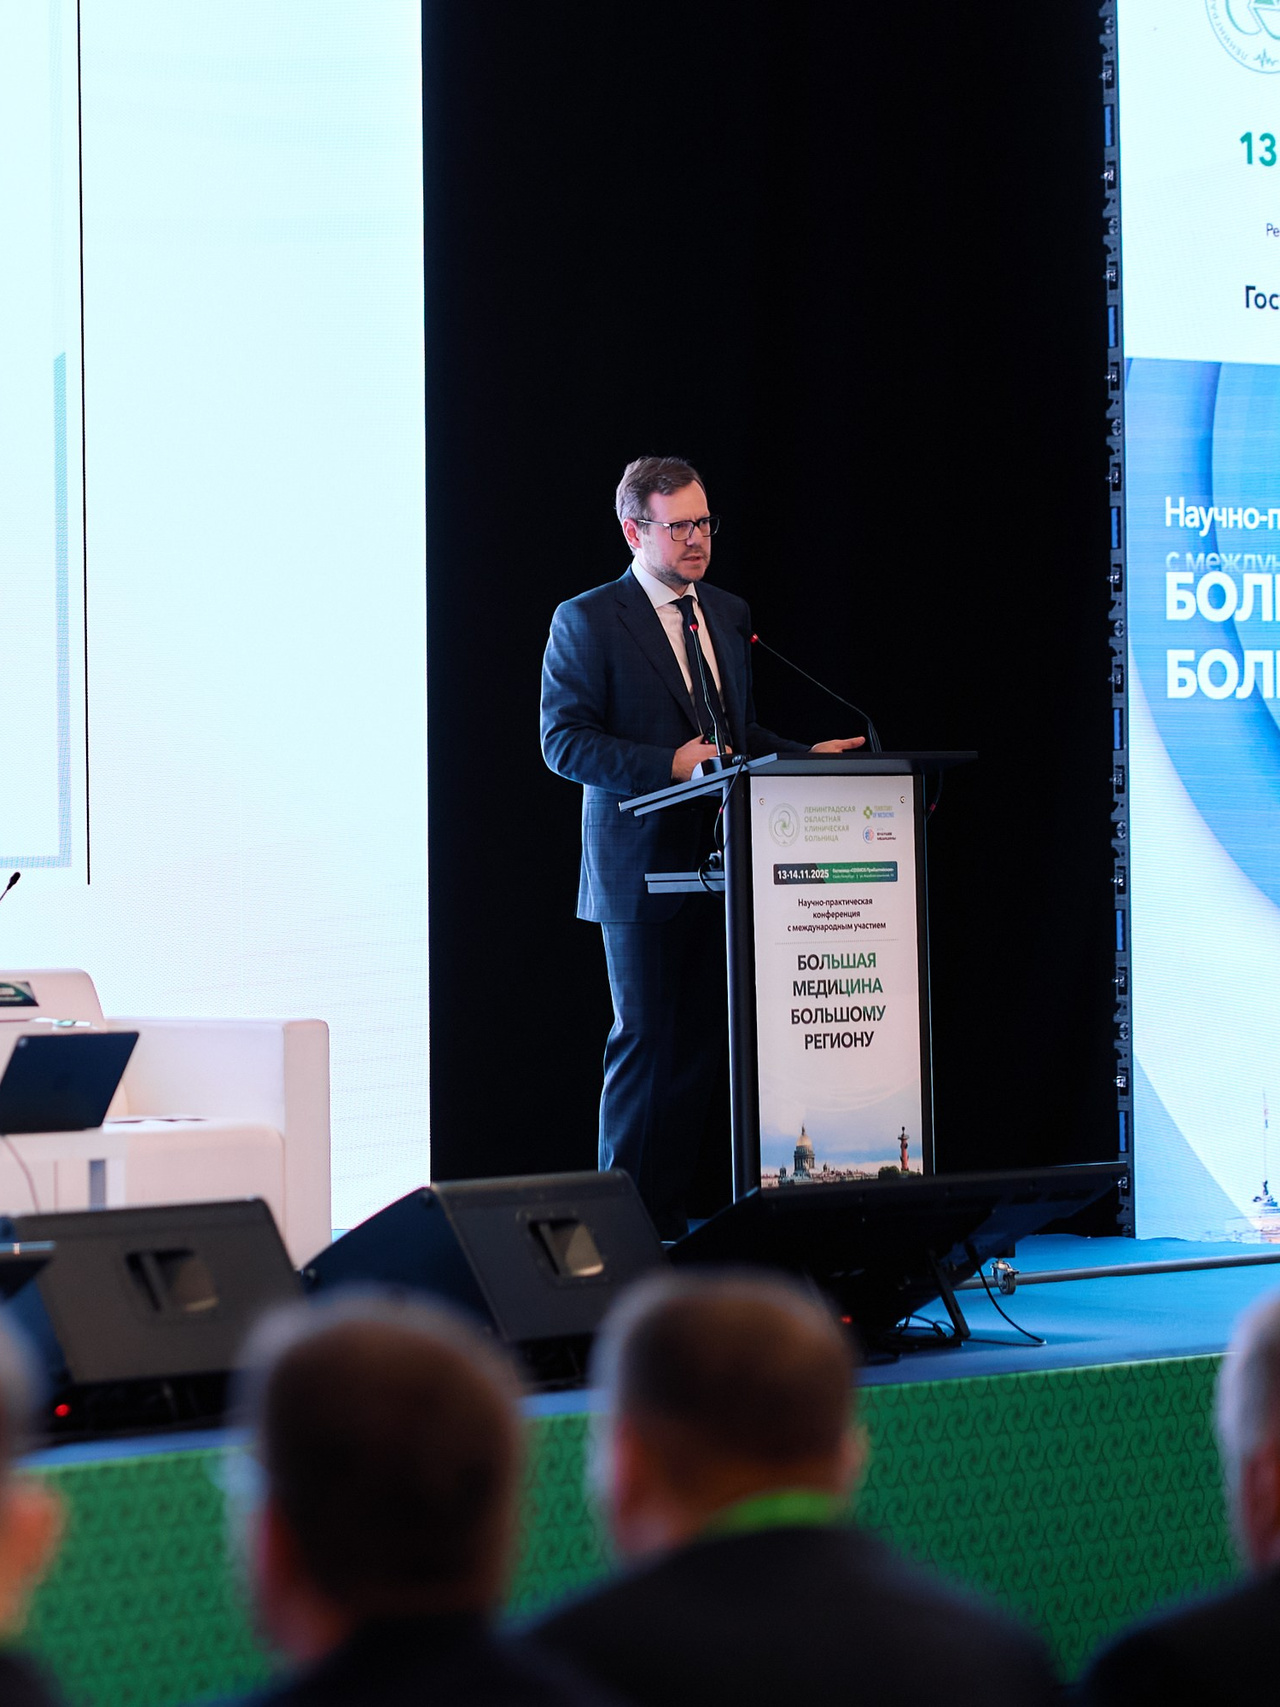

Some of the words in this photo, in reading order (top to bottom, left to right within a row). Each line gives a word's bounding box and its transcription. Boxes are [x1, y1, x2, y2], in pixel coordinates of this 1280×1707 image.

[1239, 131, 1277, 167] 13
[1245, 284, 1280, 310] Гос
[1165, 496, 1280, 537] Научно-п
[1166, 551, 1180, 571] с
[1167, 648, 1280, 700] БОЛ
[803, 815, 841, 823] ОБЛАСТНАЯ
[804, 806, 856, 814] ЛЕНИНГРАДСКАЯ
[804, 834, 839, 842] БОЛЬНИЦА
[777, 869, 830, 880] 13-14.11.2025
[798, 898, 873, 908] Научно-практическая
[812, 911, 861, 920] конференция
[792, 923, 853, 933] международным
[854, 922, 887, 932] участием
[797, 952, 877, 971] БОЛЬШАЯ
[792, 977, 884, 999] МЕДИЦИНА
[791, 1005, 887, 1025] БОЛЬШОМУ
[804, 1031, 875, 1050] РЕГИОНУ
